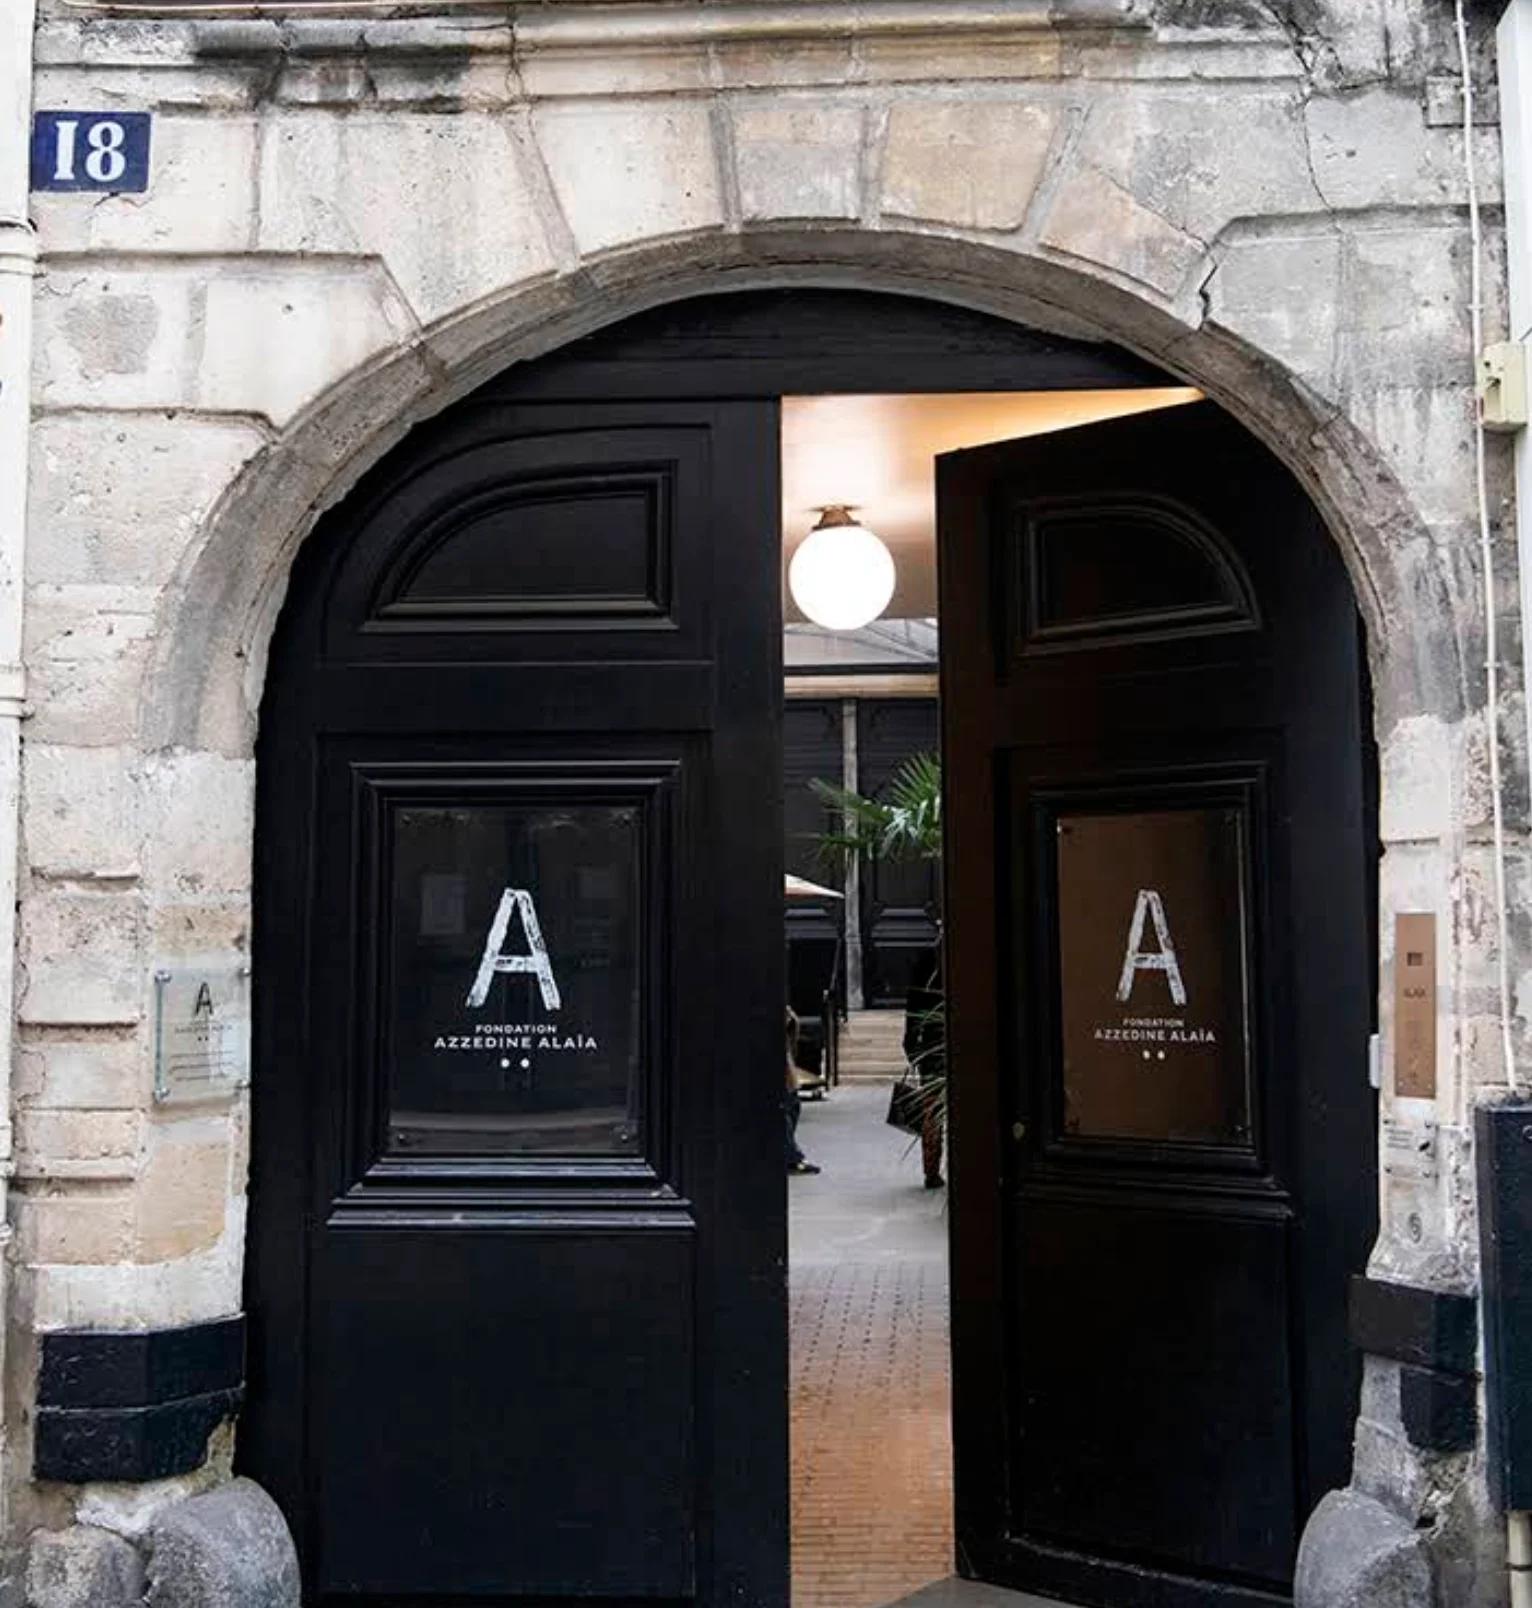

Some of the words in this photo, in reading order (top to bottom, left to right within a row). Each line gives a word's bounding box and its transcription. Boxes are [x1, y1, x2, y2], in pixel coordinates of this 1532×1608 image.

[53, 120, 126, 182] 18
[465, 887, 561, 1011] A
[1116, 889, 1187, 1006] A
[195, 981, 213, 1016] A
[475, 1024, 557, 1034] FONDATION
[1094, 1029, 1165, 1041] AZZEDINE
[1123, 1018, 1185, 1027] FONDATION
[434, 1036, 532, 1049] AZZEDINE
[538, 1034, 598, 1049] ALAÏA
